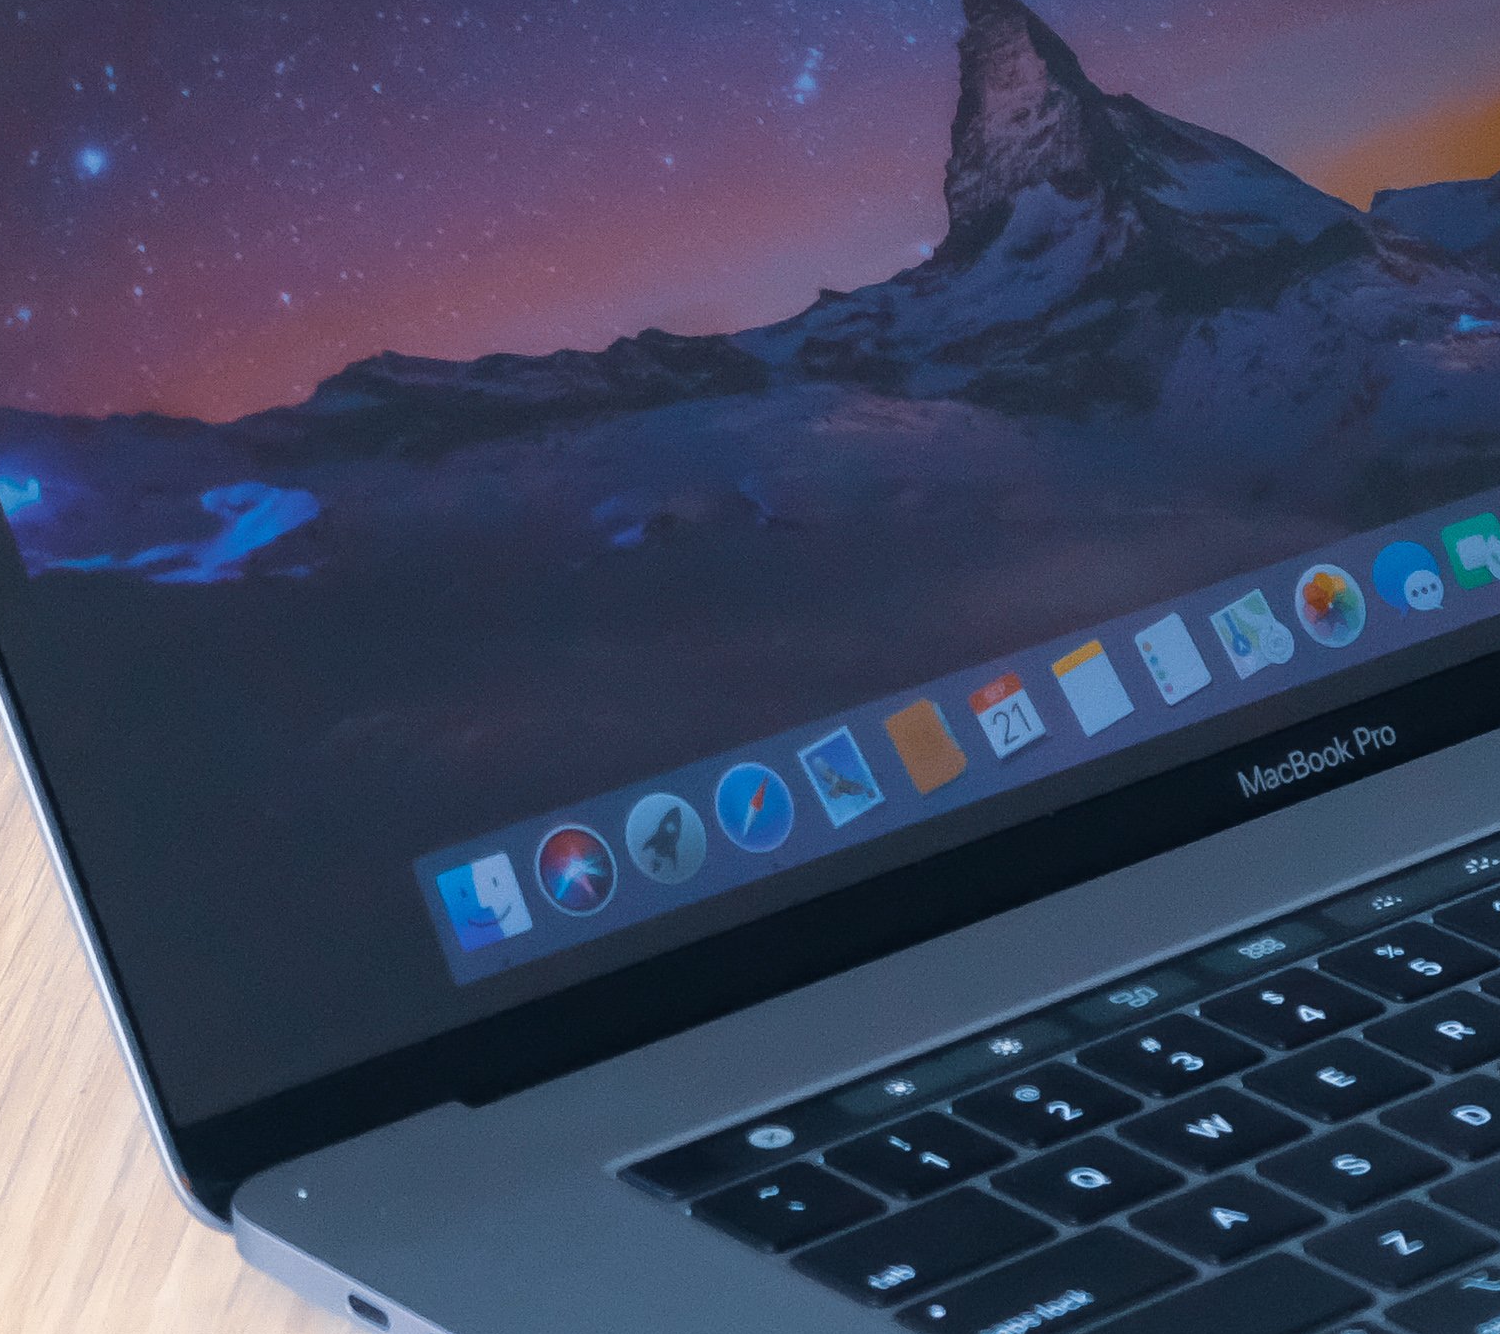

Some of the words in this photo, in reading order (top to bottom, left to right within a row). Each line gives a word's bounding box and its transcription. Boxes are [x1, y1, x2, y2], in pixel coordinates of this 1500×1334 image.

[991, 701, 1032, 745] 21
[1236, 736, 1354, 799] MacBook
[1352, 725, 1397, 756] Pro
[1407, 957, 1443, 977] 5
[1296, 1004, 1327, 1023] 4
[1435, 1020, 1476, 1041] R
[1169, 1051, 1205, 1072] 3
[1316, 1066, 1357, 1089] E
[1045, 1100, 1084, 1122] 2
[1451, 1104, 1492, 1127] D
[1185, 1113, 1234, 1139] W
[1332, 1153, 1372, 1177] S
[1210, 1206, 1250, 1230] A
[1379, 1230, 1424, 1256] Z
